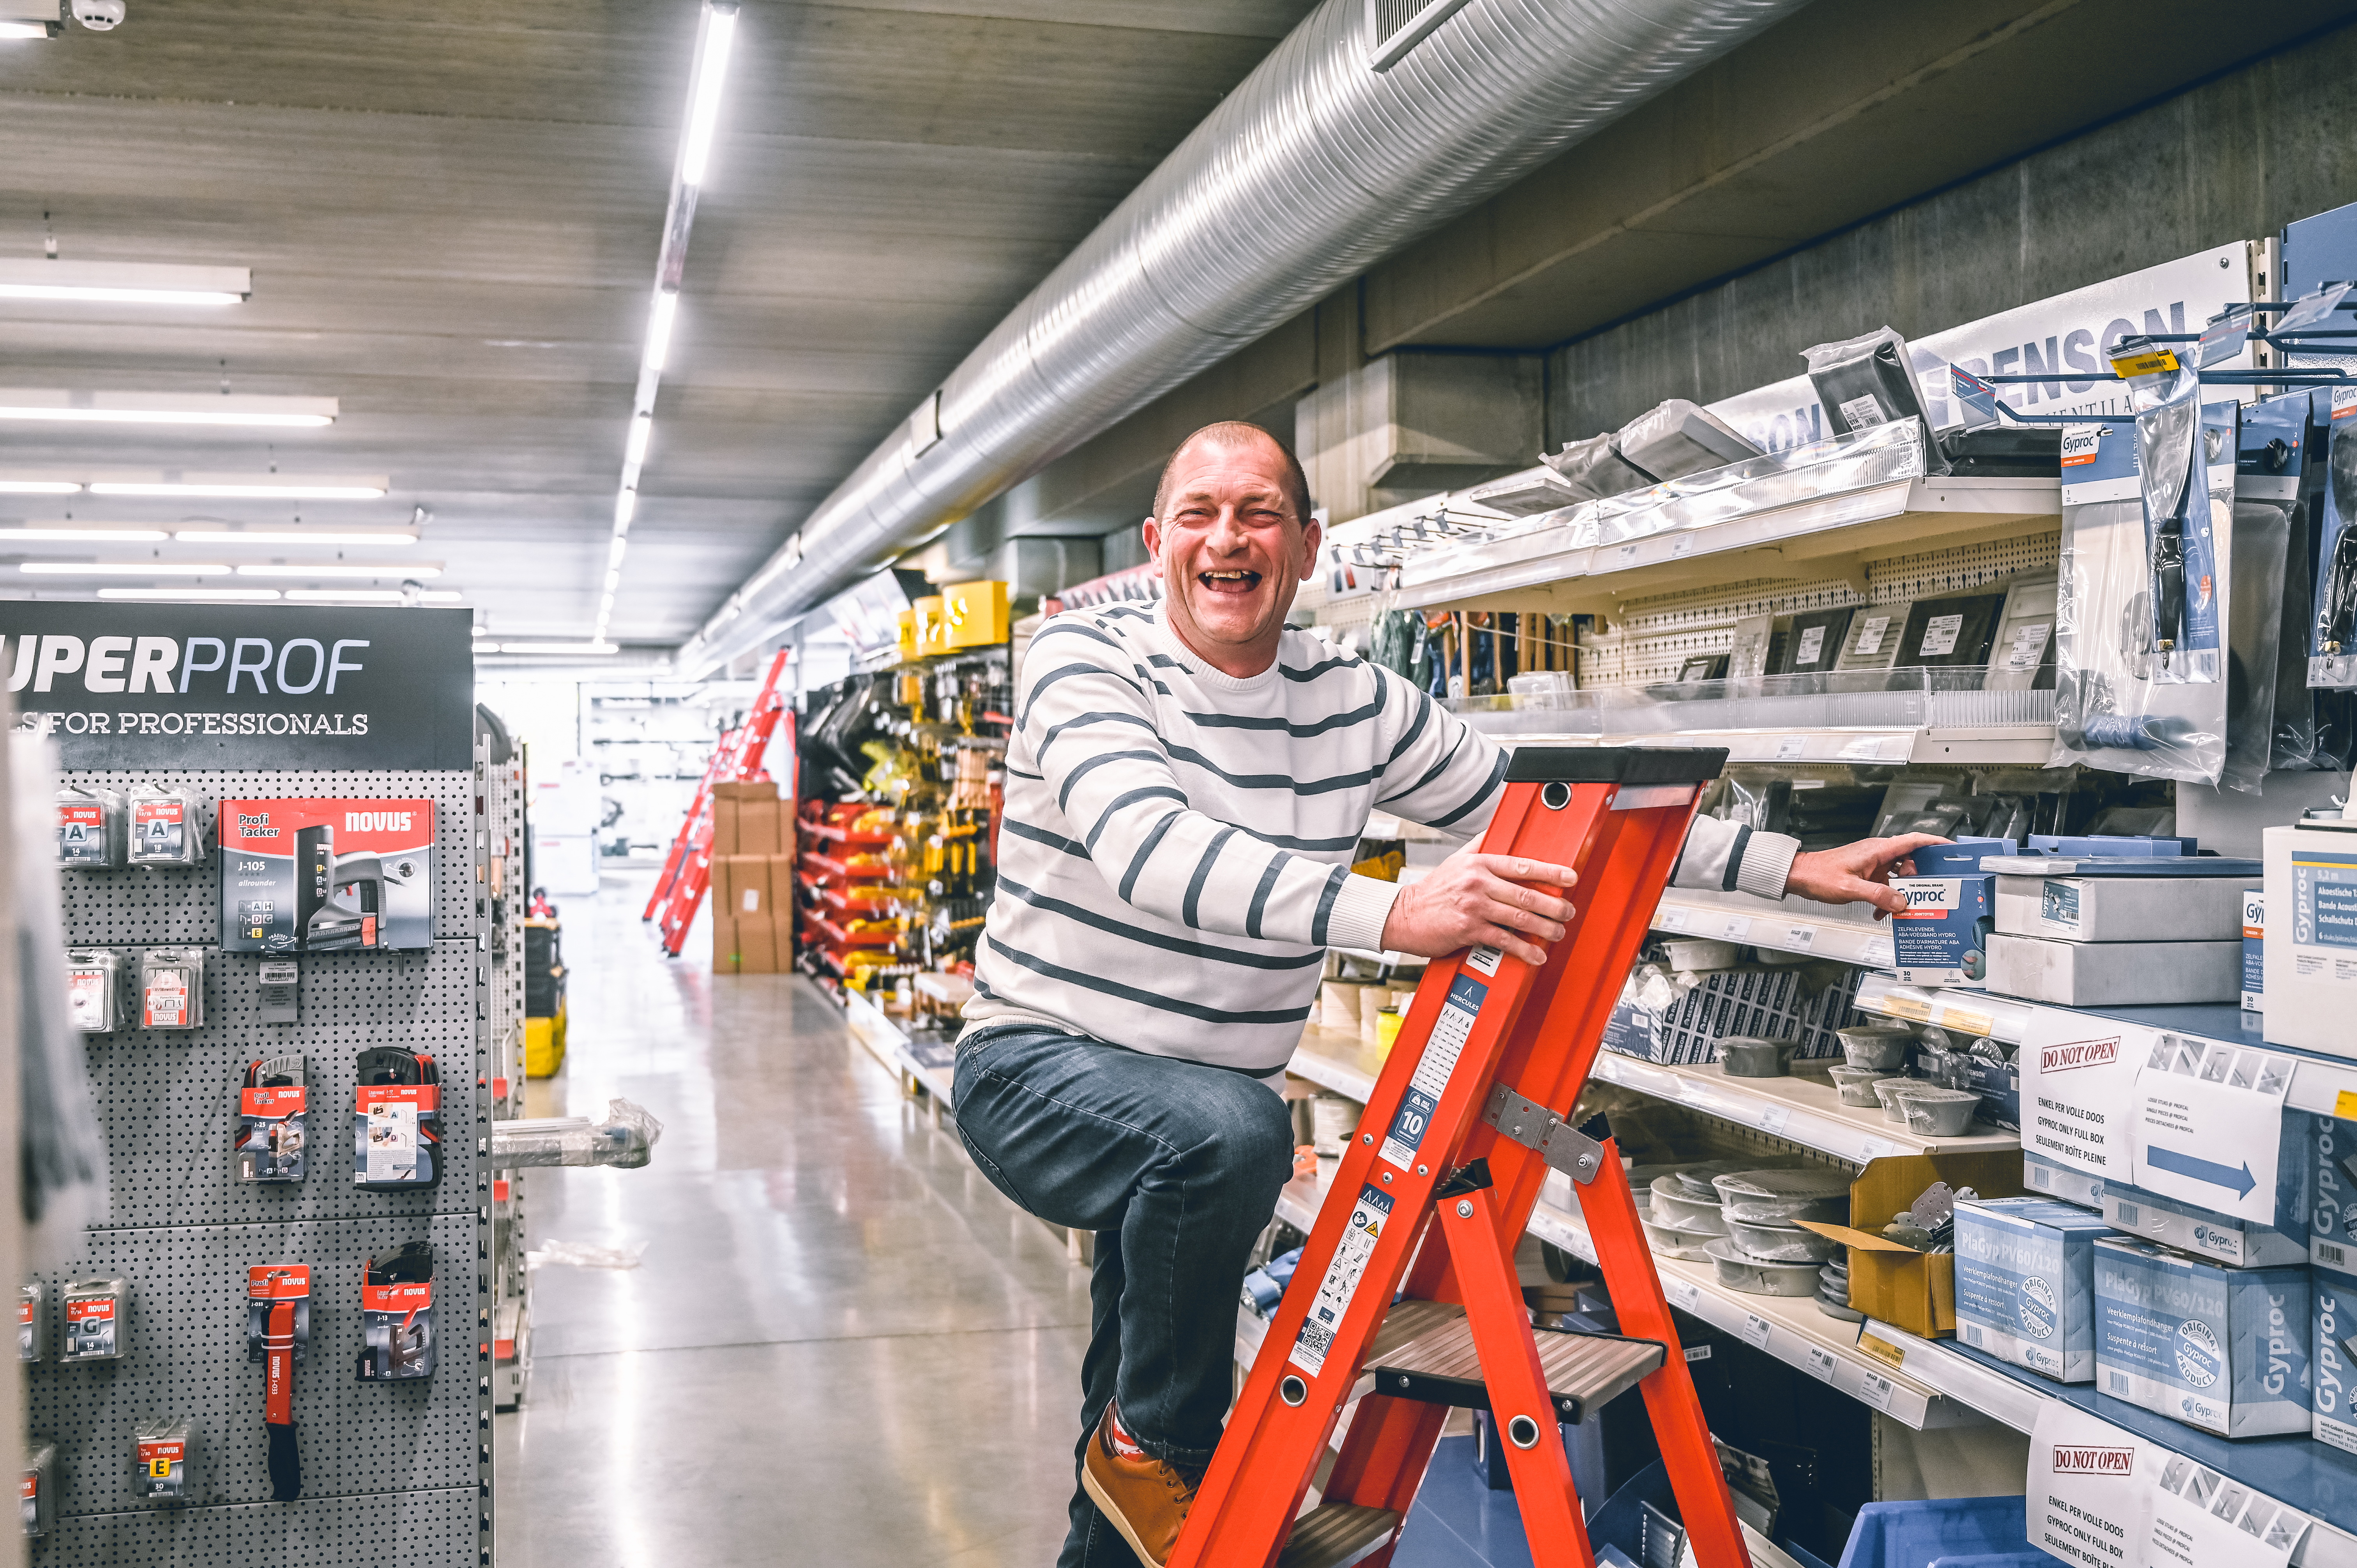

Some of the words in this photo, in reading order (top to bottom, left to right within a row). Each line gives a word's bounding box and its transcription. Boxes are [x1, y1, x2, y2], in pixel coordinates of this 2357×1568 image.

[2063, 436, 2094, 453] Gyproc
[47, 712, 110, 734] FOR
[118, 713, 368, 735] PROFESSIONALS
[152, 822, 165, 835] A
[239, 813, 269, 825] Profi
[69, 825, 83, 839] A
[239, 826, 280, 837] Tacker
[238, 862, 265, 871] J-105
[2296, 868, 2311, 943] Gyproc
[2318, 901, 2337, 910] Bande
[161, 975, 173, 986] D
[1450, 992, 1480, 1012] HERCULES
[1687, 992, 1697, 1021] RENSON
[1704, 996, 1713, 1024] RENSON
[1719, 1001, 1729, 1028] RENSON
[1675, 1035, 1686, 1061] RENSON
[2043, 1051, 2058, 1068] DO
[2060, 1046, 2084, 1065] NOT
[2085, 1042, 2117, 1061] OPEN
[2038, 1097, 2055, 1110] ENKEL
[2055, 1102, 2065, 1114] PER
[2066, 1105, 2084, 1119] VOLLE
[2086, 1110, 2104, 1124] DOOS
[1404, 1111, 1423, 1135] 10
[2037, 1116, 2058, 1131] GYPROC
[2059, 1121, 2073, 1136] ONLY
[2074, 1127, 2088, 1140] FULL
[2090, 1132, 2104, 1144] BOX
[2036, 1134, 2064, 1153] SEULEMENT
[2065, 1145, 2082, 1159] BOÎTE
[2083, 1151, 2106, 1165] PLEINE
[2314, 1117, 2339, 1234] Gyproc
[1359, 1199, 1388, 1218] PROFESSIONAL
[1963, 1232, 1999, 1261] PlaGyp
[2002, 1243, 2059, 1275] PV60/120
[1963, 1264, 2018, 1289] Veerklemplafondhanger
[1963, 1289, 1984, 1302] Suspente
[1984, 1295, 1988, 1303] à
[1988, 1297, 2004, 1309] ressort
[2025, 1278, 2055, 1308] ORIGINAL
[2026, 1297, 2050, 1321] Gyproc
[2107, 1306, 2173, 1333] Veerklemplafondhanger
[84, 1319, 97, 1333] G
[2021, 1308, 2049, 1337] PRODUCT
[2107, 1333, 2132, 1347] Suspente
[2133, 1340, 2137, 1348] à
[2138, 1342, 2157, 1354] ressort
[2182, 1322, 2216, 1354] ORIGINAL
[2263, 1294, 2291, 1395] Gyproc
[1812, 1349, 1822, 1357] SALCO
[2183, 1342, 2212, 1368] Gyproc
[2315, 1295, 2342, 1413] Gyproc
[1866, 1372, 1877, 1381] SALCO
[2178, 1354, 2212, 1385] PRODUCT
[156, 1460, 164, 1474] E
[2055, 1450, 2071, 1468] DO
[2073, 1451, 2097, 1469] NOT
[2098, 1451, 2131, 1470] OPEN
[2049, 1495, 2068, 1512] ENKEL
[2069, 1504, 2081, 1519] PER
[2083, 1511, 2102, 1528] VOLLE
[2104, 1522, 2124, 1538] DOOS
[2047, 1515, 2072, 1534] GYPROC
[2074, 1527, 2091, 1543] ONLY
[2092, 1537, 2108, 1552] FULL
[2110, 1544, 2123, 1559] BOX
[2176, 1540, 2190, 1552] PROFCAL
[2179, 1530, 2193, 1542] PROFCAL
[2044, 1533, 2081, 1558] SEULEMENT
[2082, 1550, 2102, 1568] BOÎTE
[2179, 1554, 2193, 1565] PROFCAL
